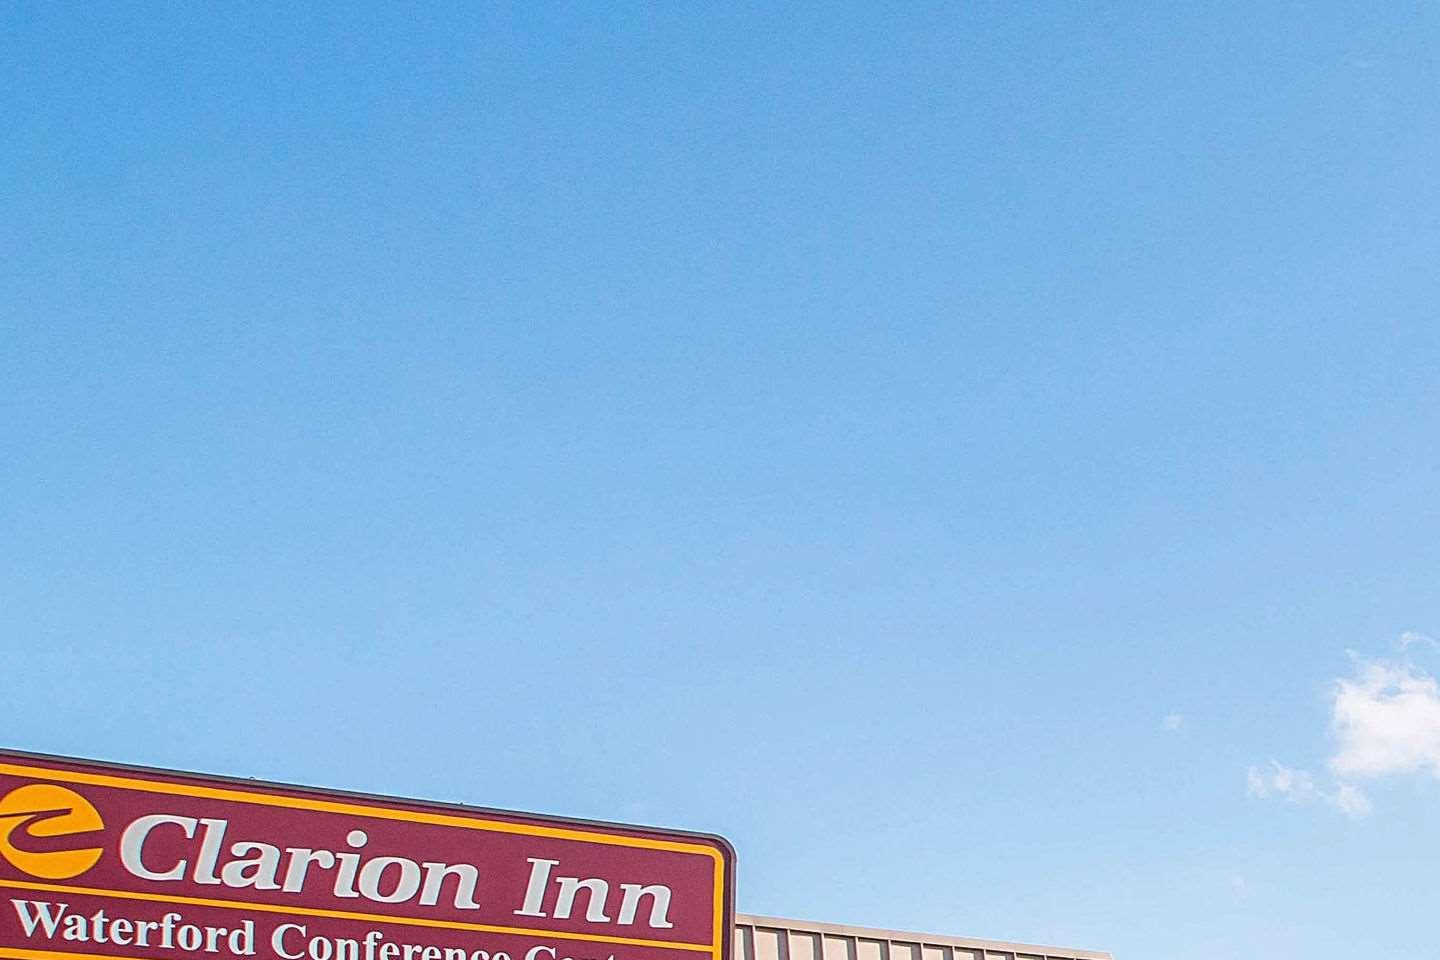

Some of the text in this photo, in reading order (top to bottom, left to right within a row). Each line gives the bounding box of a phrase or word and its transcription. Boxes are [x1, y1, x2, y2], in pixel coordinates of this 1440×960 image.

[119, 813, 674, 929] Clarion Inn
[11, 899, 256, 955] Waterford
